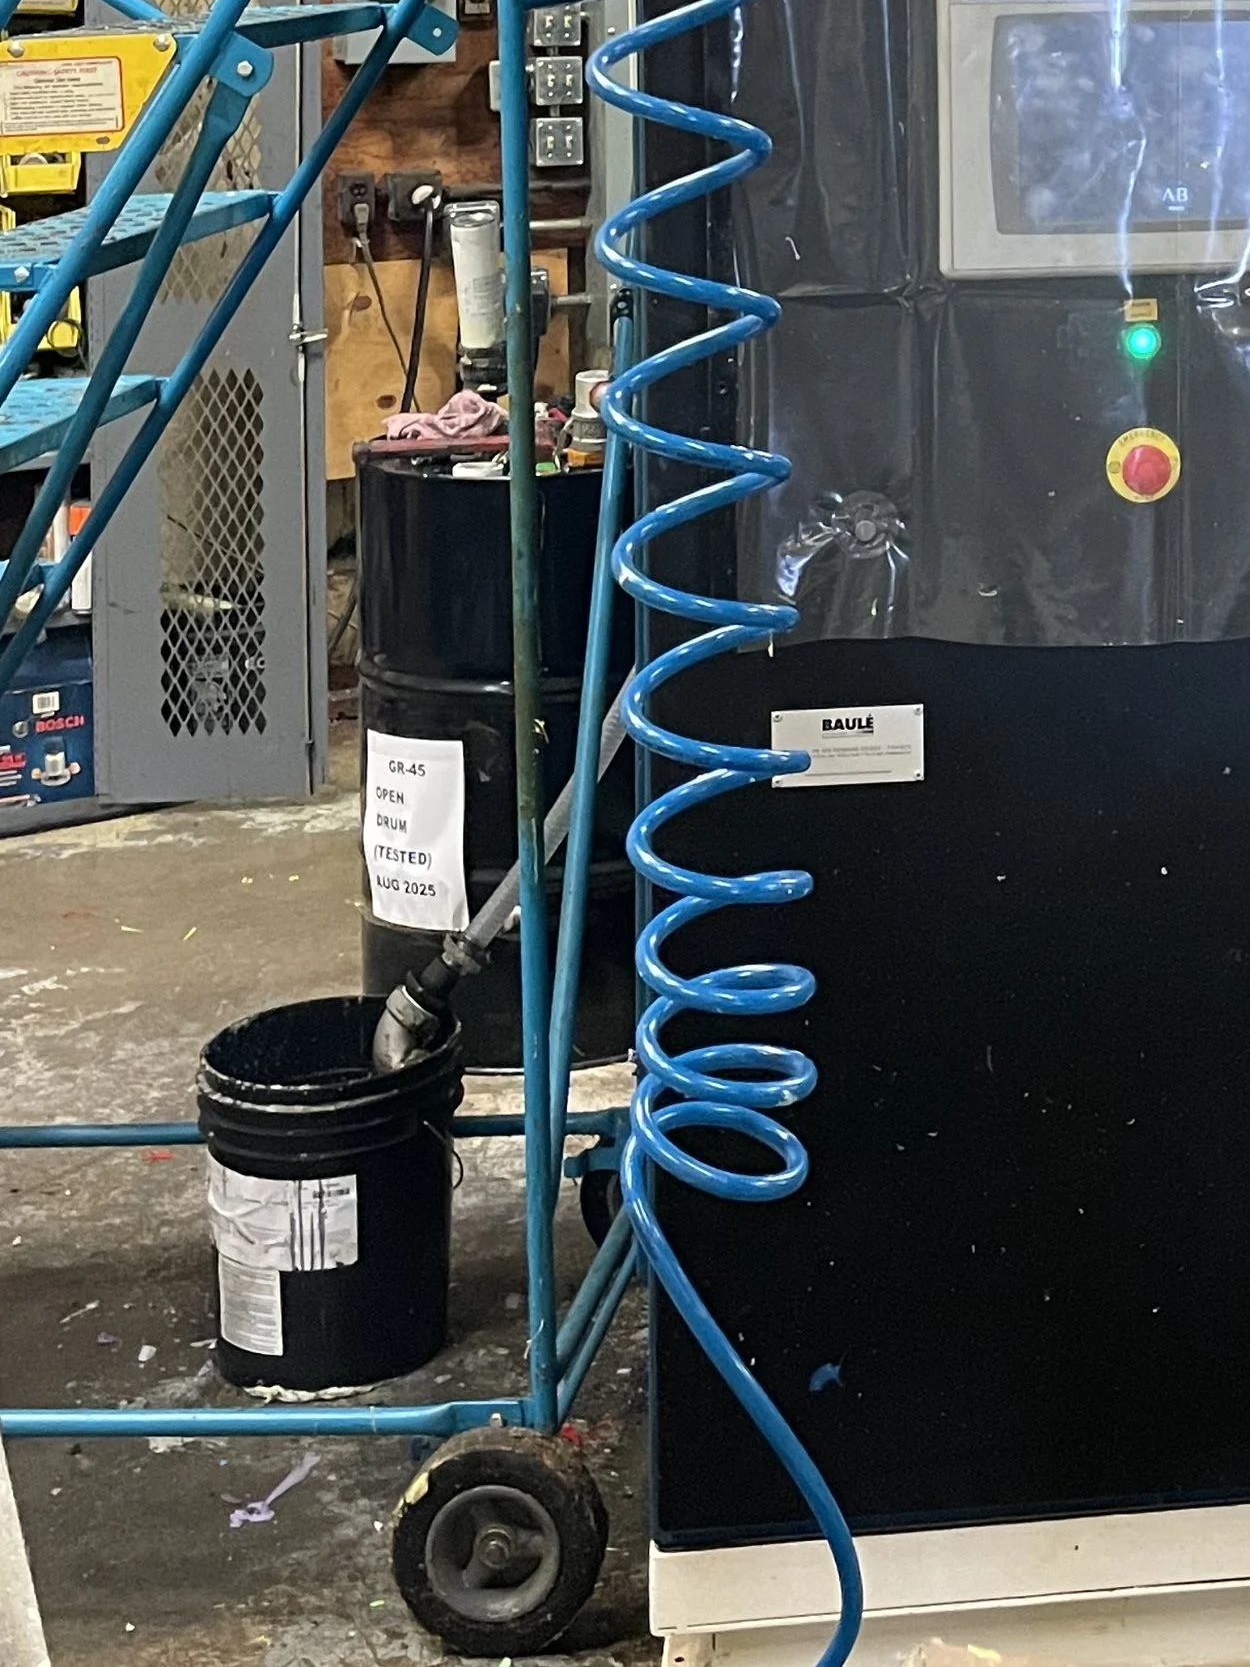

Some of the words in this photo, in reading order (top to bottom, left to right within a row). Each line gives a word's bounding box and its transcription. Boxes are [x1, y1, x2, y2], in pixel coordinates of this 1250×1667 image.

[35, 715, 85, 733] BOSCH
[822, 714, 874, 731] BAULÉ
[388, 760, 426, 777] GR-45
[376, 786, 405, 805] OPEN
[376, 813, 408, 834] DRUM
[374, 844, 433, 870] (TESTED)
[376, 874, 400, 892] AUG
[404, 879, 436, 897] 2025
